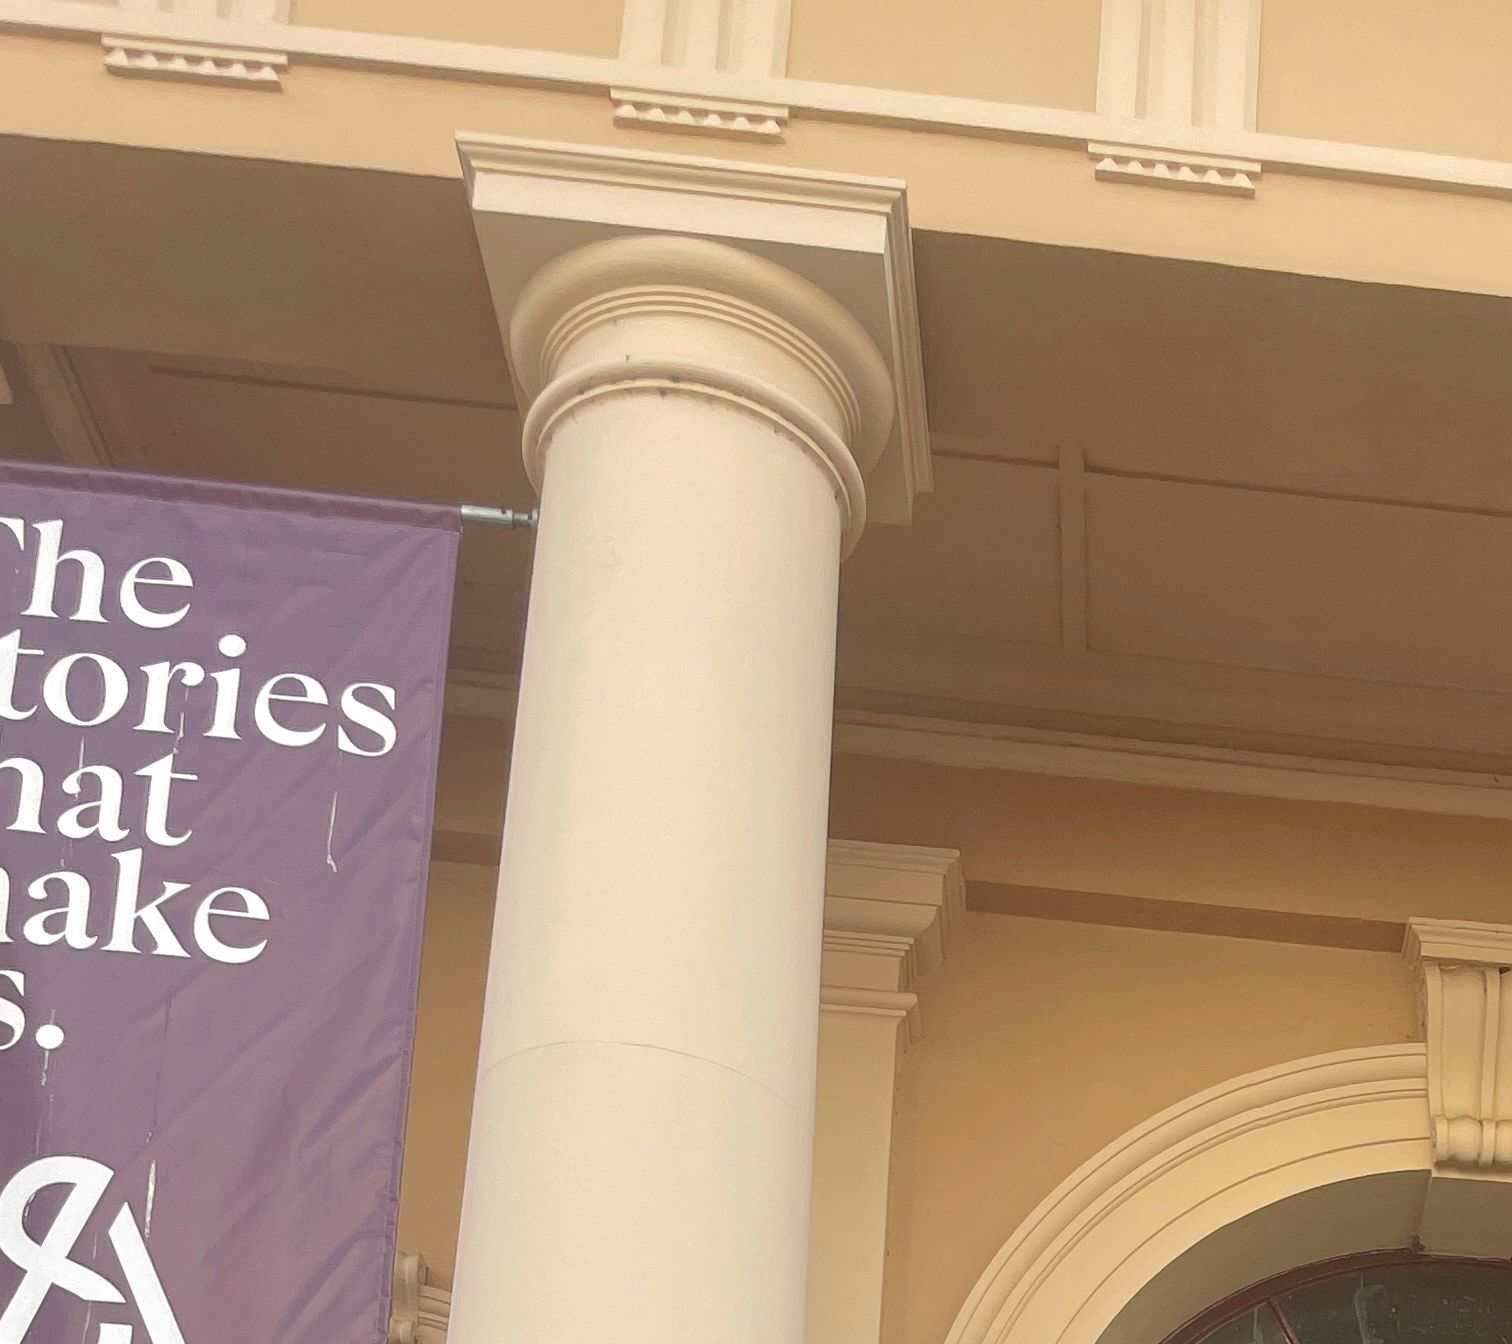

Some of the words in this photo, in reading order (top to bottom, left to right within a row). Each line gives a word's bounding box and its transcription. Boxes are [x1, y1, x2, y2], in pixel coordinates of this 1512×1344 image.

[0, 516, 194, 629] he
[0, 629, 397, 757] tories
[0, 847, 270, 964] ake
